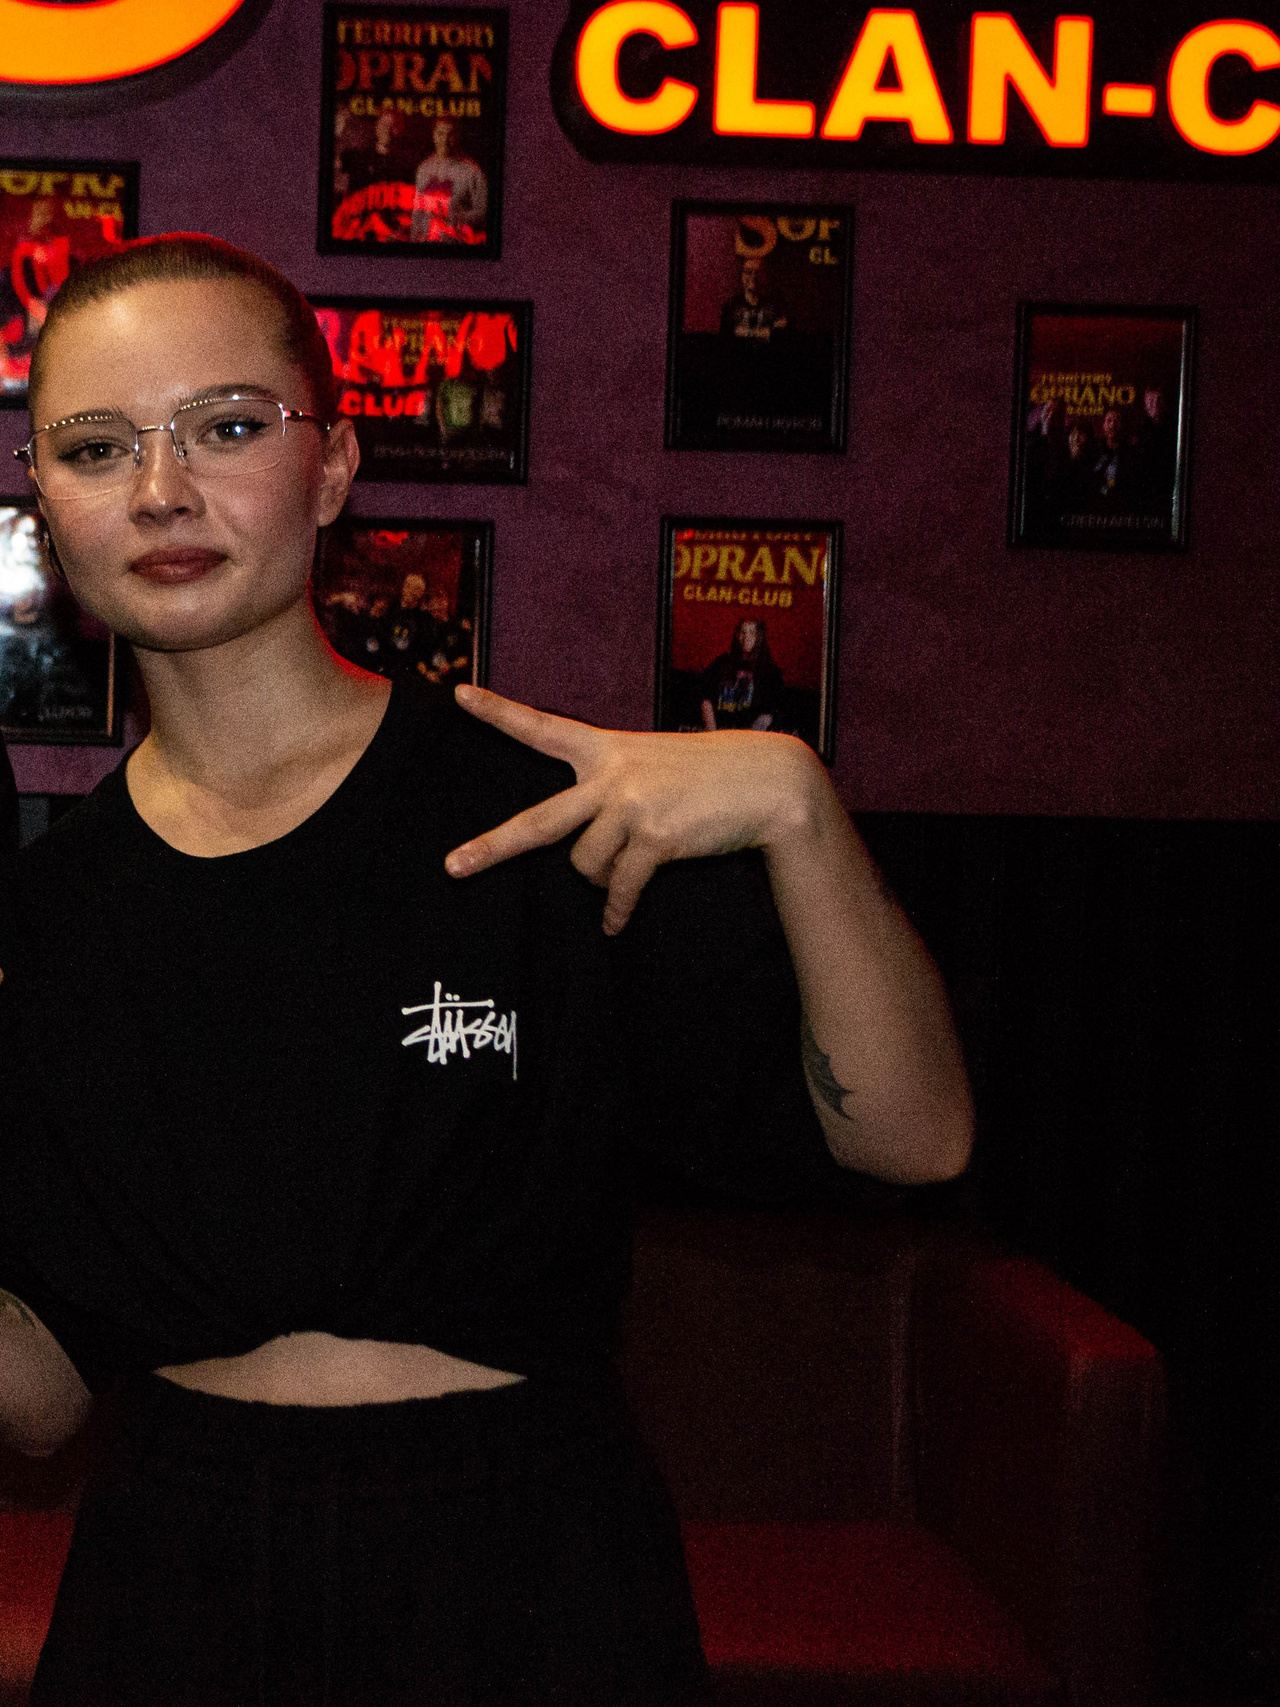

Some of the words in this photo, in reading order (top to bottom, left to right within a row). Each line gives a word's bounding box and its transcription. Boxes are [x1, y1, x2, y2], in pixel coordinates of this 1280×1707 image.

[575, 0, 1280, 157] CLAN-C
[674, 544, 826, 586] OPRAN
[683, 584, 793, 608] CLAN-CLUB
